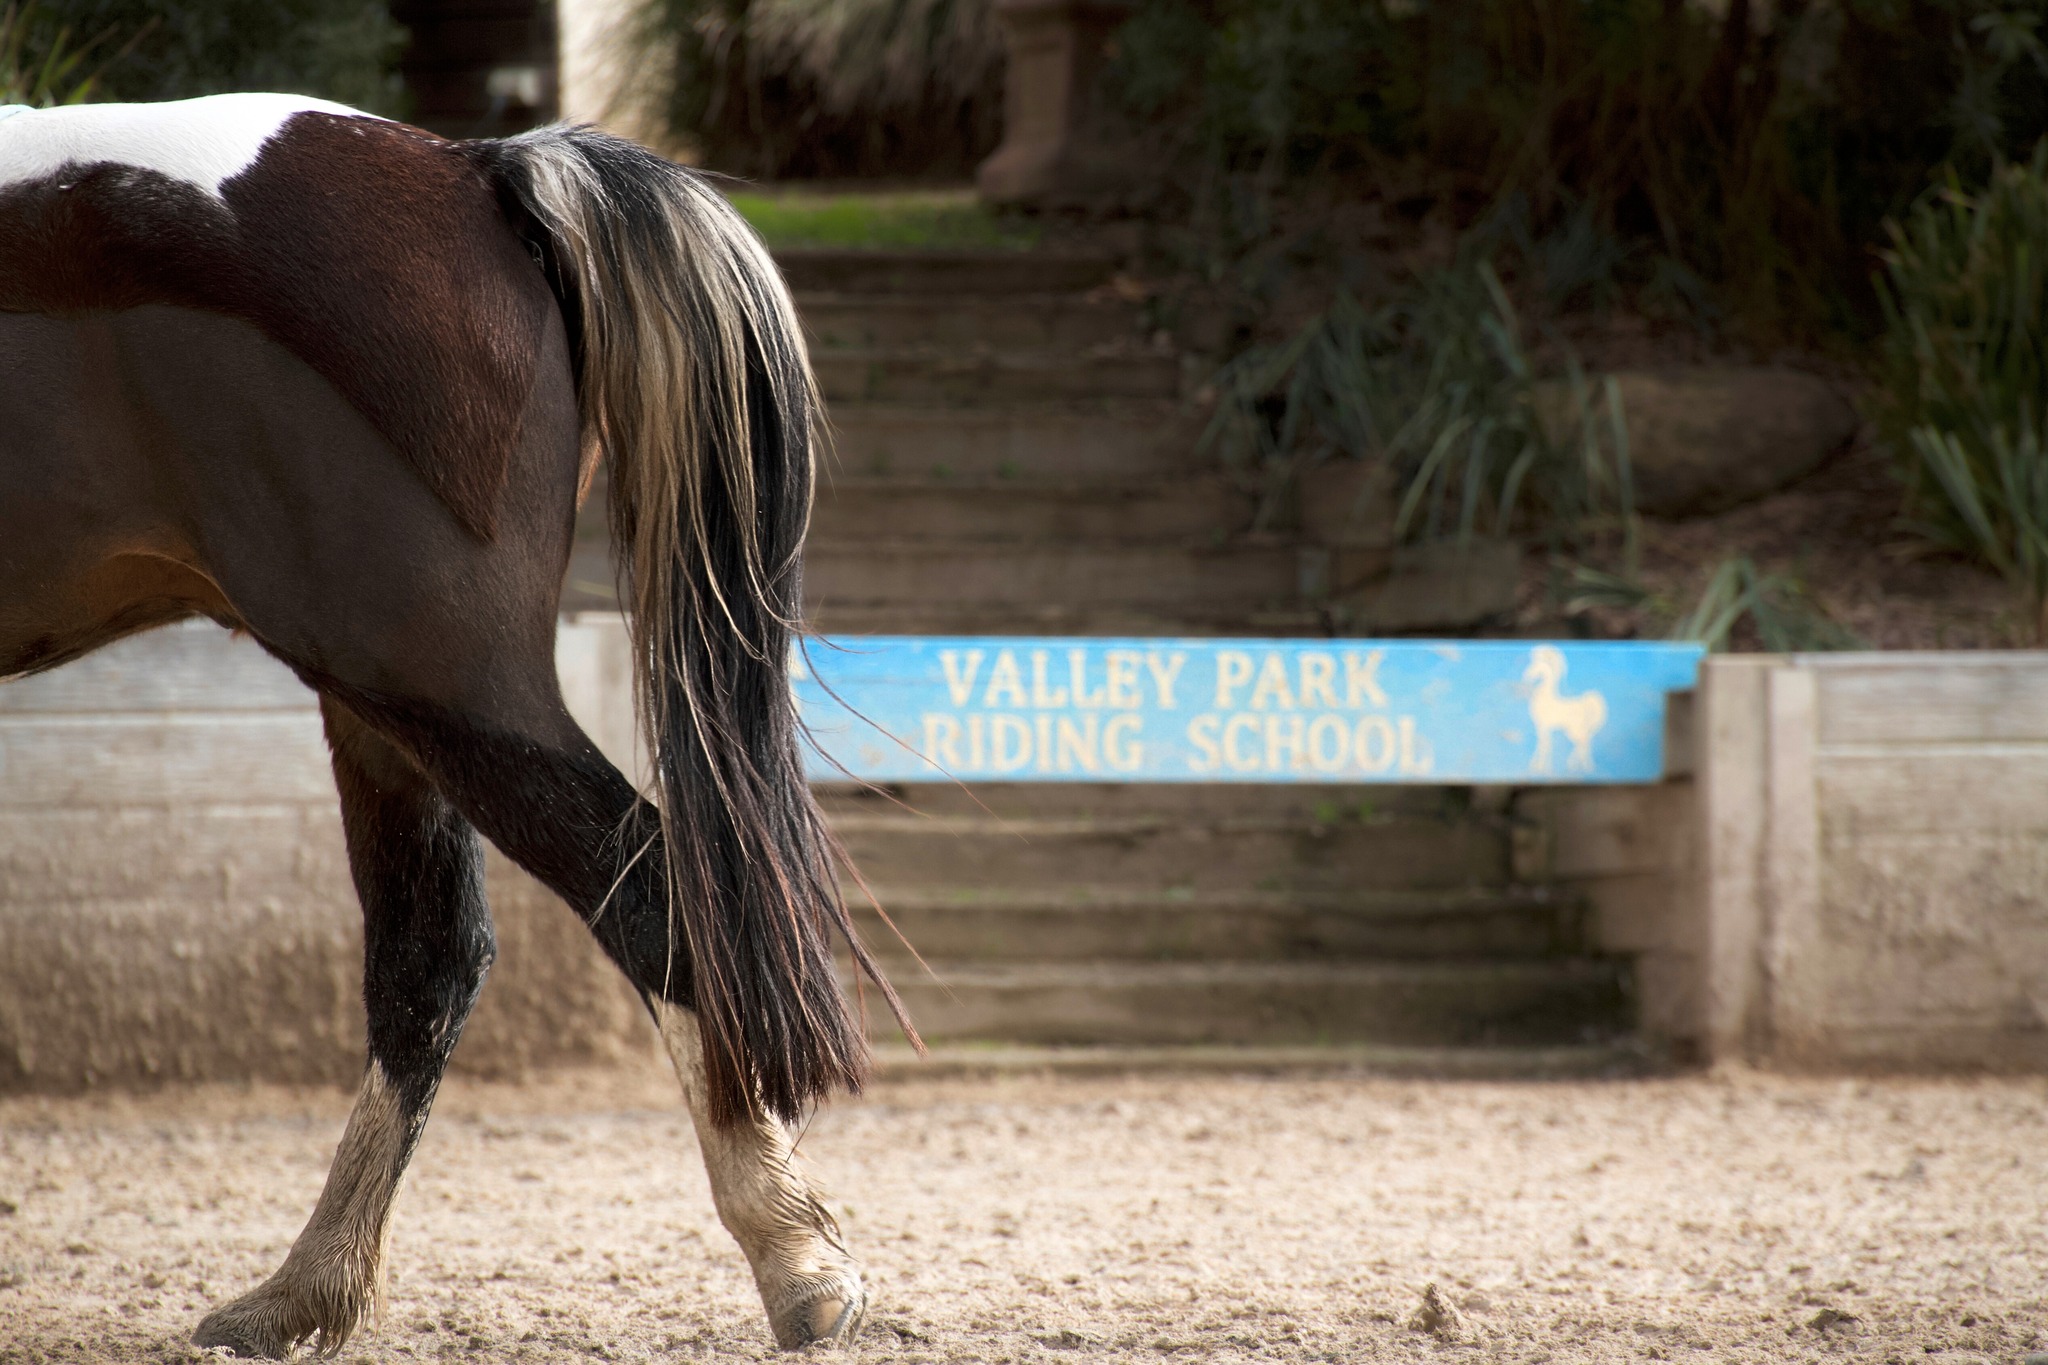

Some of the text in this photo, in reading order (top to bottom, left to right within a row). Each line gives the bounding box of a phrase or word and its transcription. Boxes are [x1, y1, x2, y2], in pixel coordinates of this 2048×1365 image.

[939, 649, 1389, 710] VALLEY PARK
[921, 713, 1436, 774] RIDING SCHOOL
